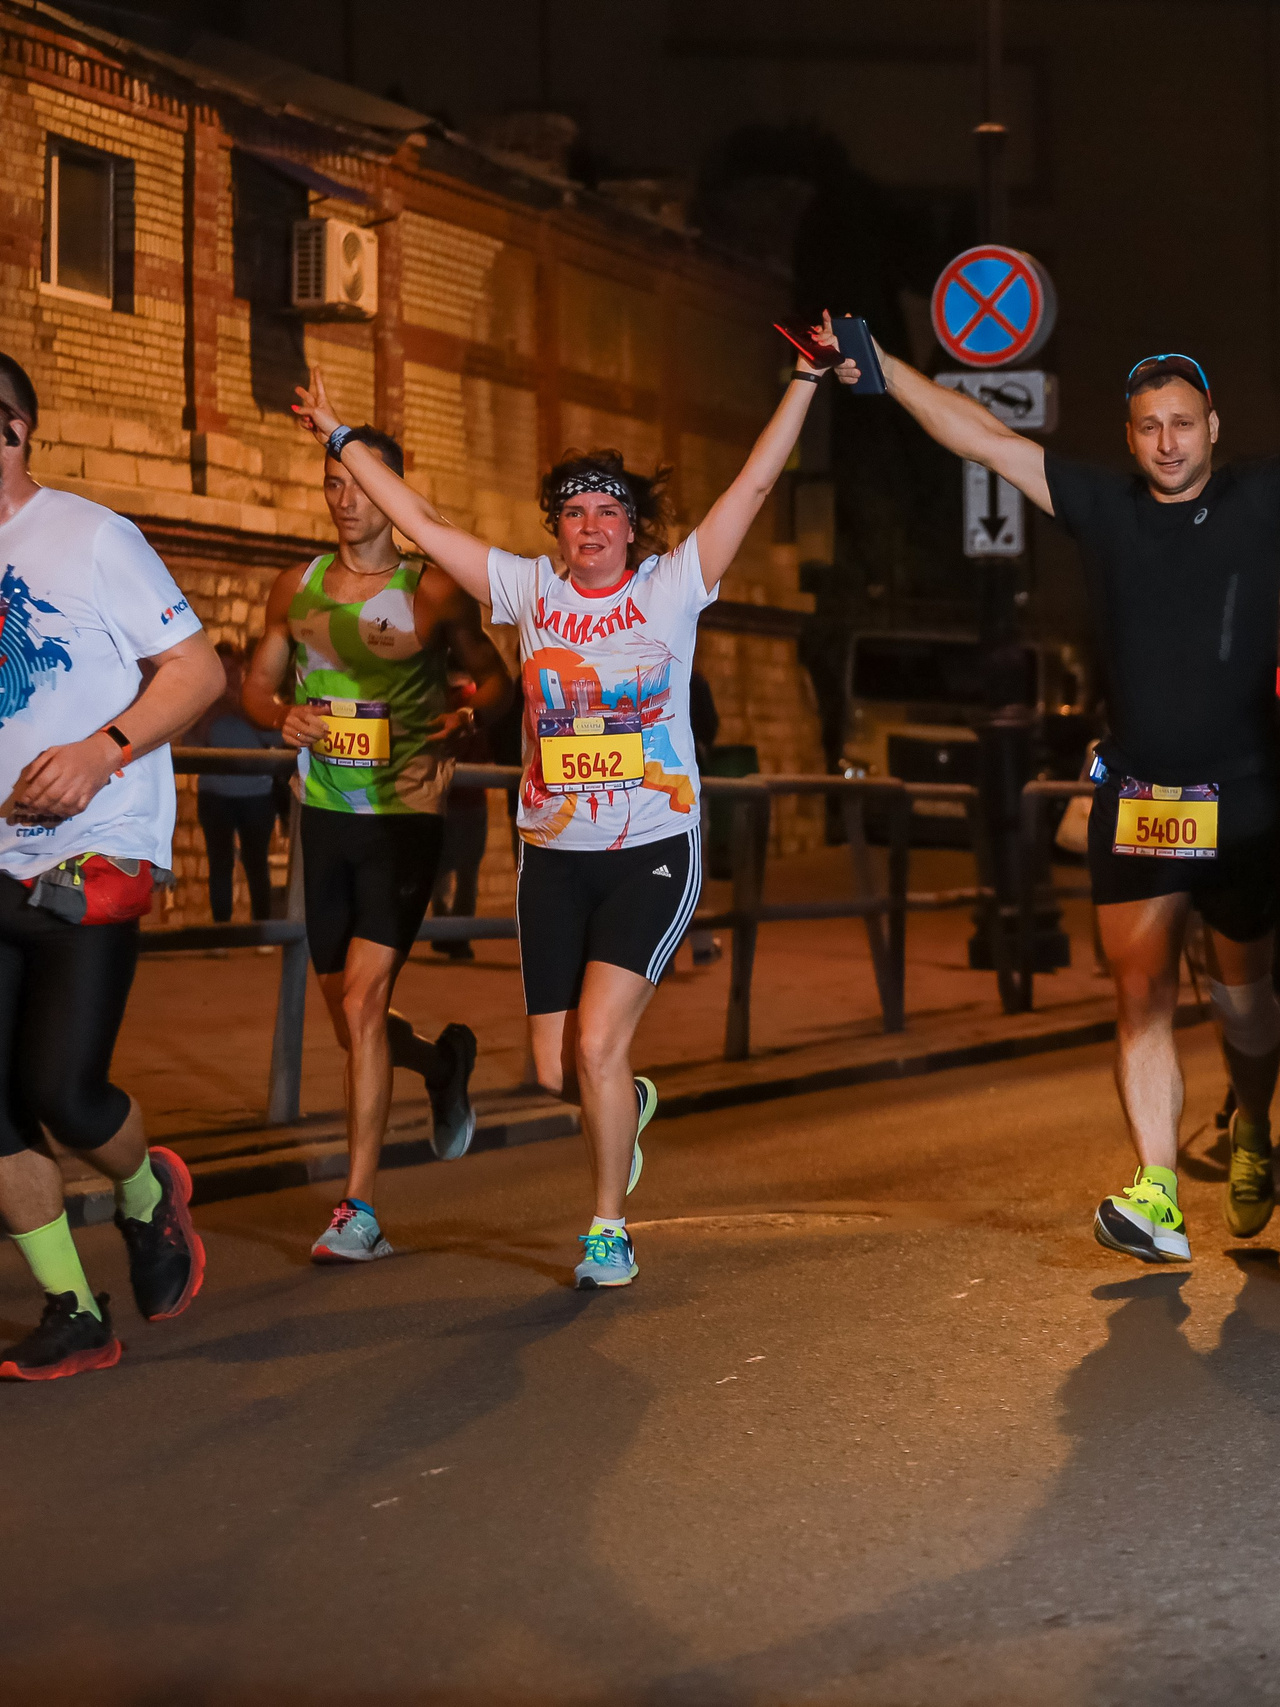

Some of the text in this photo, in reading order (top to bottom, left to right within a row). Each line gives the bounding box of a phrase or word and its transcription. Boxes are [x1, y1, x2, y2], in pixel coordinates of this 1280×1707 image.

[324, 730, 370, 756] 5479
[561, 750, 624, 780] 5642
[16, 827, 56, 838] СТАРТ!
[1136, 816, 1197, 844] 5400
